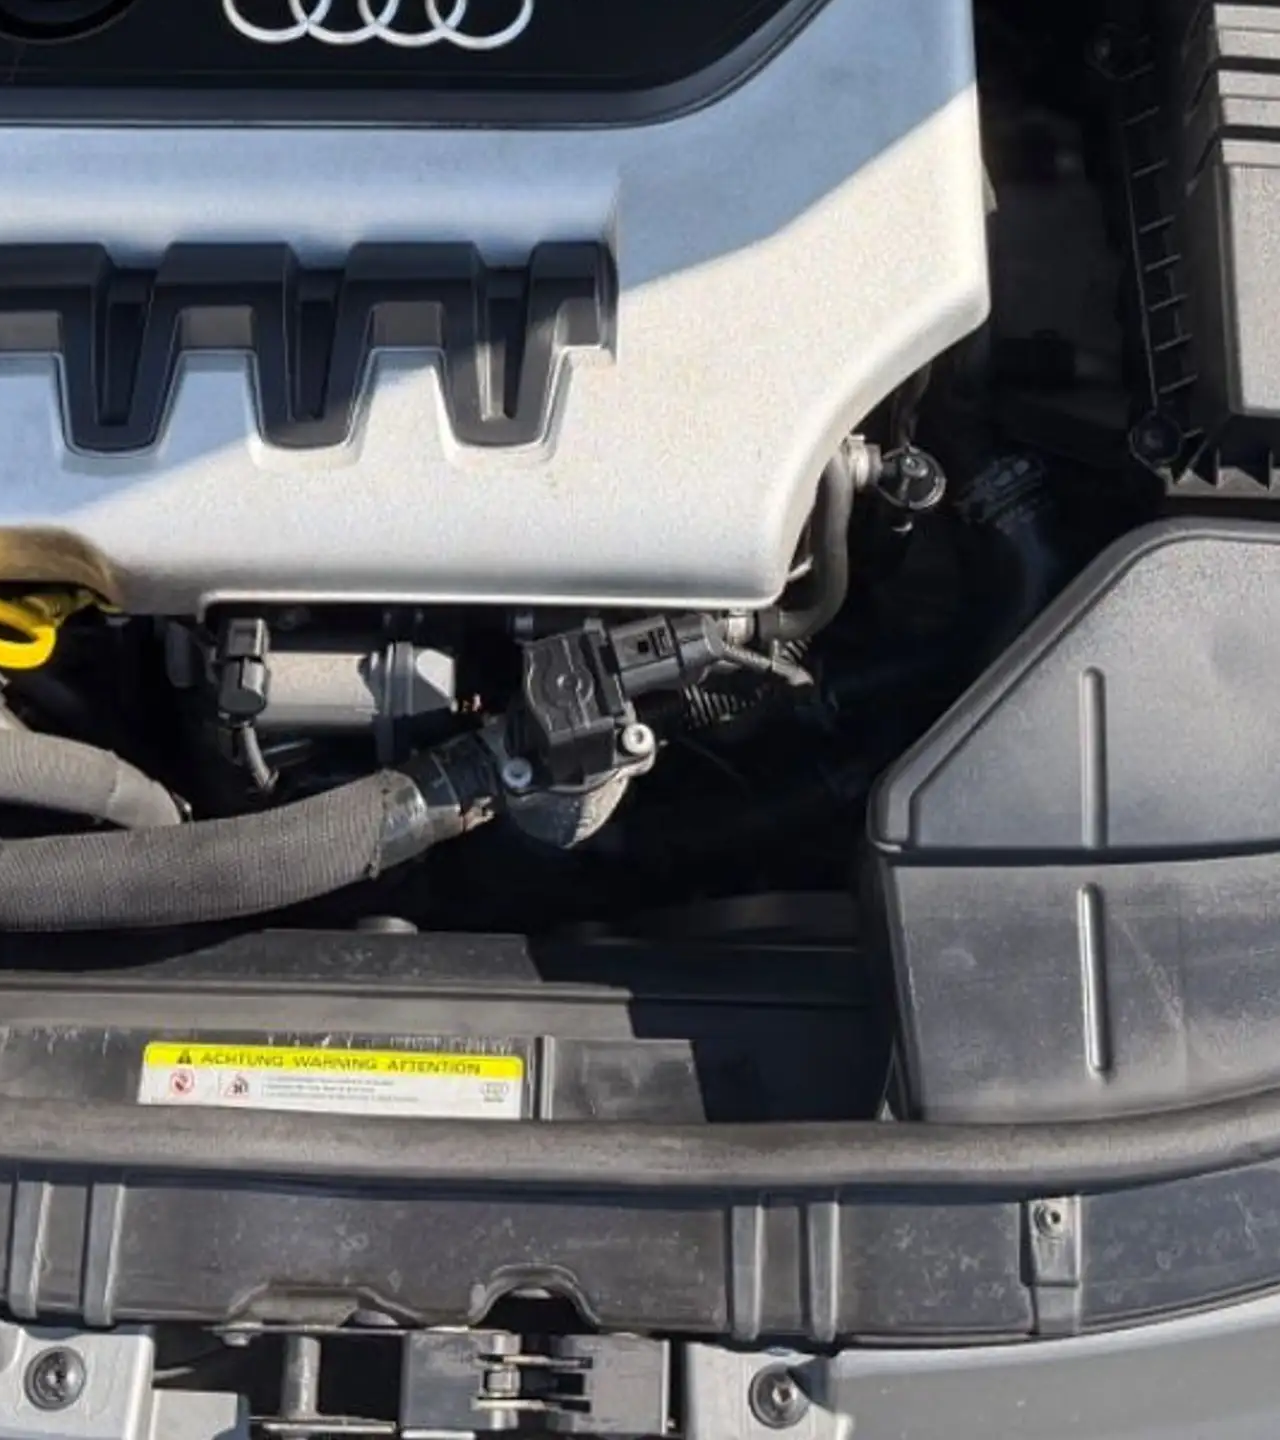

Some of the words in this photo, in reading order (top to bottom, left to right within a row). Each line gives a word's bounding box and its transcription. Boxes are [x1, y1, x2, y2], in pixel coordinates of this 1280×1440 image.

[201, 1053, 284, 1068] ACHTUNG
[293, 1056, 378, 1071] WARNING
[387, 1059, 480, 1076] ATTENTION
